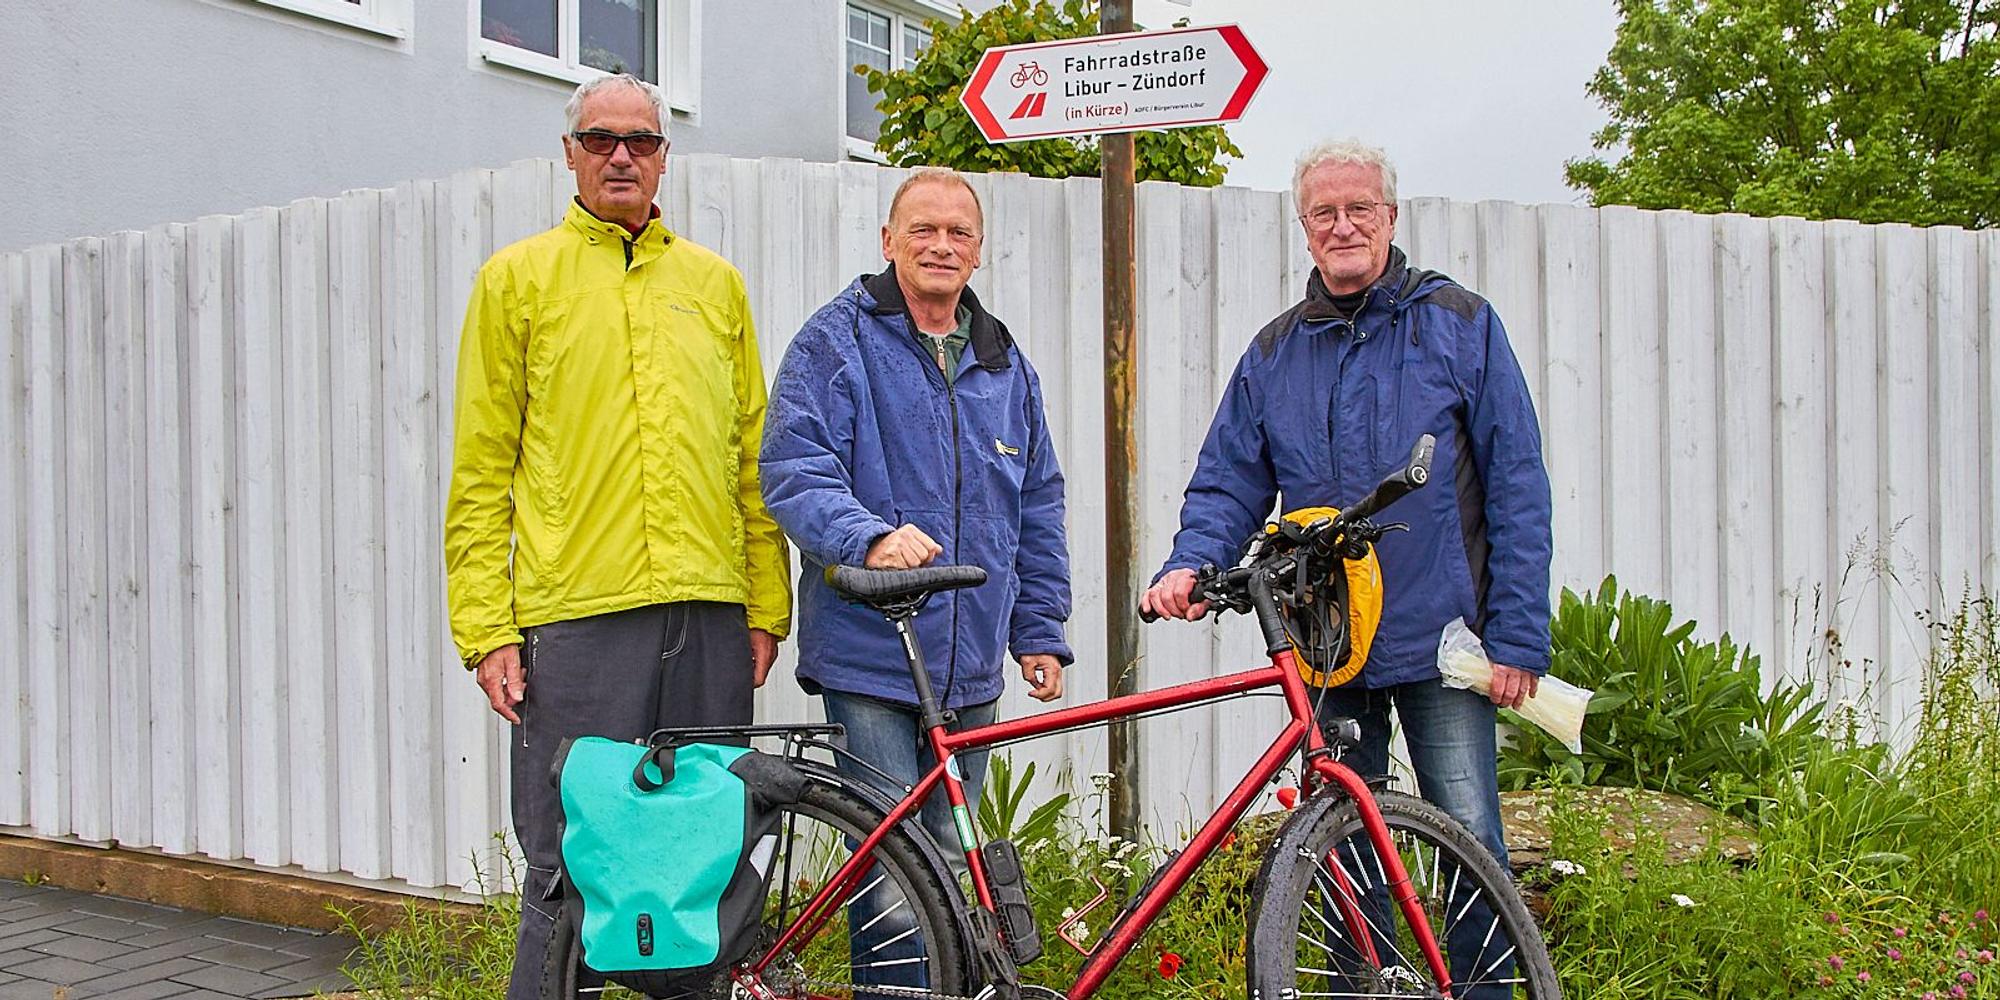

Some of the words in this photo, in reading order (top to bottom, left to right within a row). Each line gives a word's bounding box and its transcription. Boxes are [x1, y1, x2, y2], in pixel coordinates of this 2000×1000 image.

[1064, 44, 1207, 74] Fahrradstraße
[1064, 79, 1113, 98] Libur
[1132, 67, 1206, 91] Zündorf
[1065, 106, 1083, 121] (in
[1086, 101, 1129, 118] Kürze)
[1153, 103, 1189, 112] Bürgerverein
